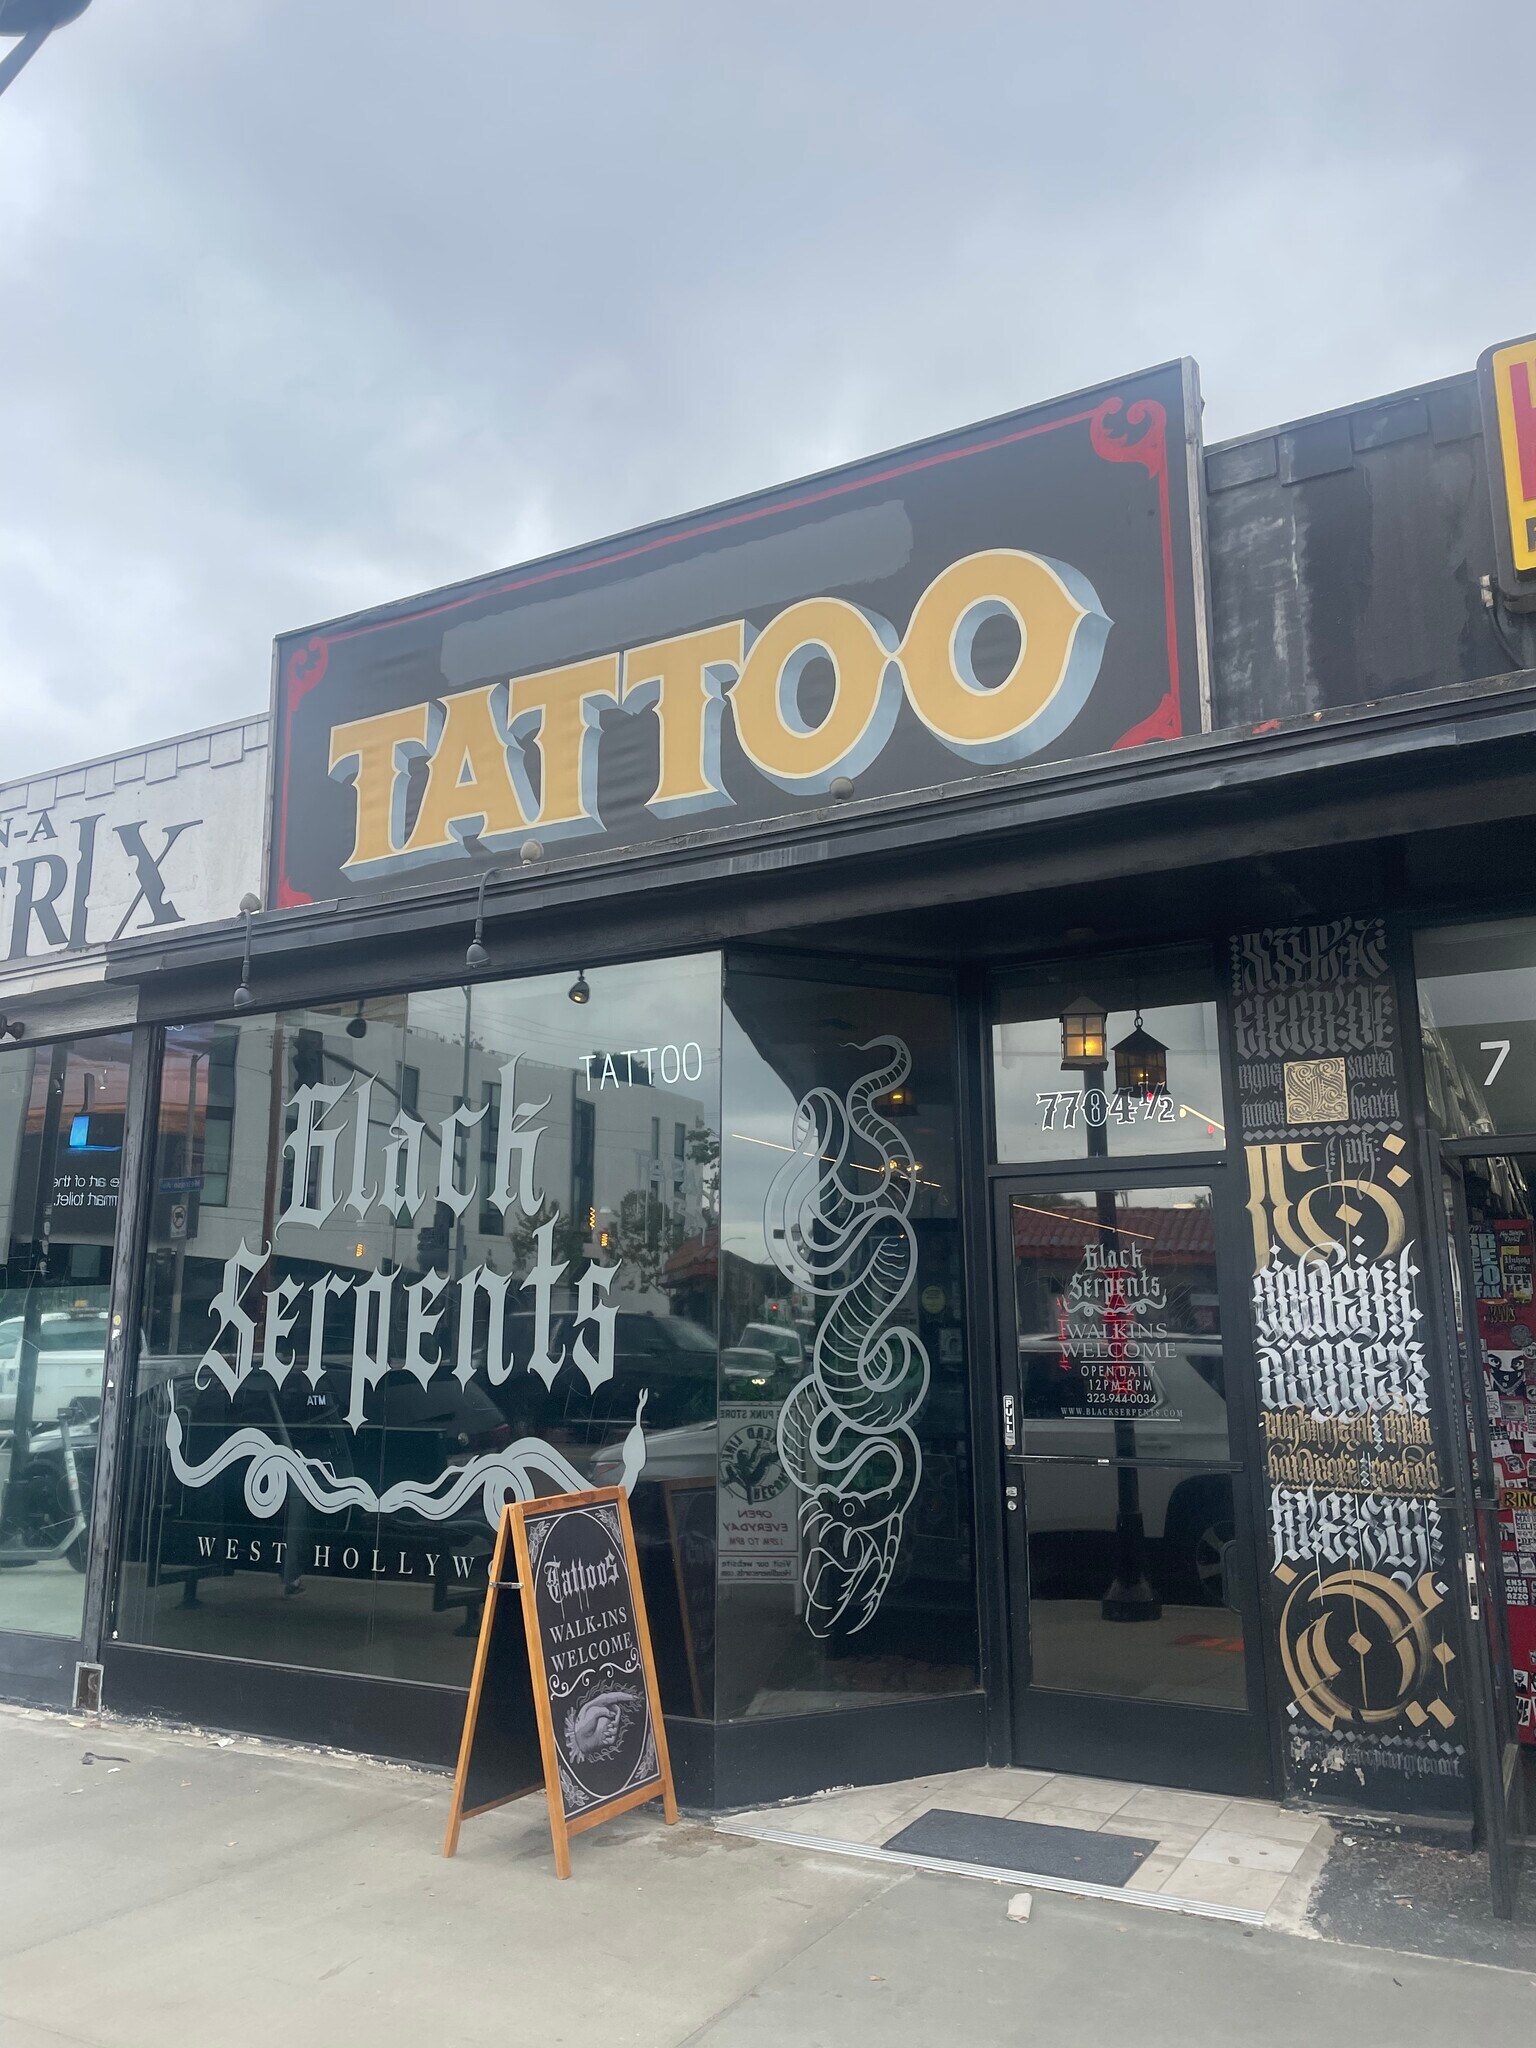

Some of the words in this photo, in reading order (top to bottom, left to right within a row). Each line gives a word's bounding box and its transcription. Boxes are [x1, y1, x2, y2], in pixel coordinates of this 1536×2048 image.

[328, 547, 1113, 882] TATTOO
[0, 813, 203, 960] RIX
[578, 1041, 703, 1093] TATTOO
[1480, 1039, 1511, 1087] 7
[275, 1051, 552, 1240] Black
[1083, 1241, 1144, 1272] Black
[1068, 1270, 1161, 1305] Serpents
[195, 1210, 622, 1435] Serpents
[1066, 1322, 1168, 1339] WALKINS
[1059, 1342, 1177, 1359] WELCOME
[1080, 1365, 1116, 1377] OPEN
[1119, 1365, 1156, 1377] DAILY
[307, 1394, 327, 1407] ATM
[1005, 1399, 1013, 1433] PULL
[1060, 1406, 1184, 1418] WWW.BLACKSERPENTS.COM
[1086, 1393, 1158, 1404] 323-944-0034
[198, 1536, 287, 1564] WEST
[314, 1544, 498, 1579] HOLLYW
[549, 1605, 628, 1645] WALK-INS
[550, 1631, 634, 1674] WELCOME
